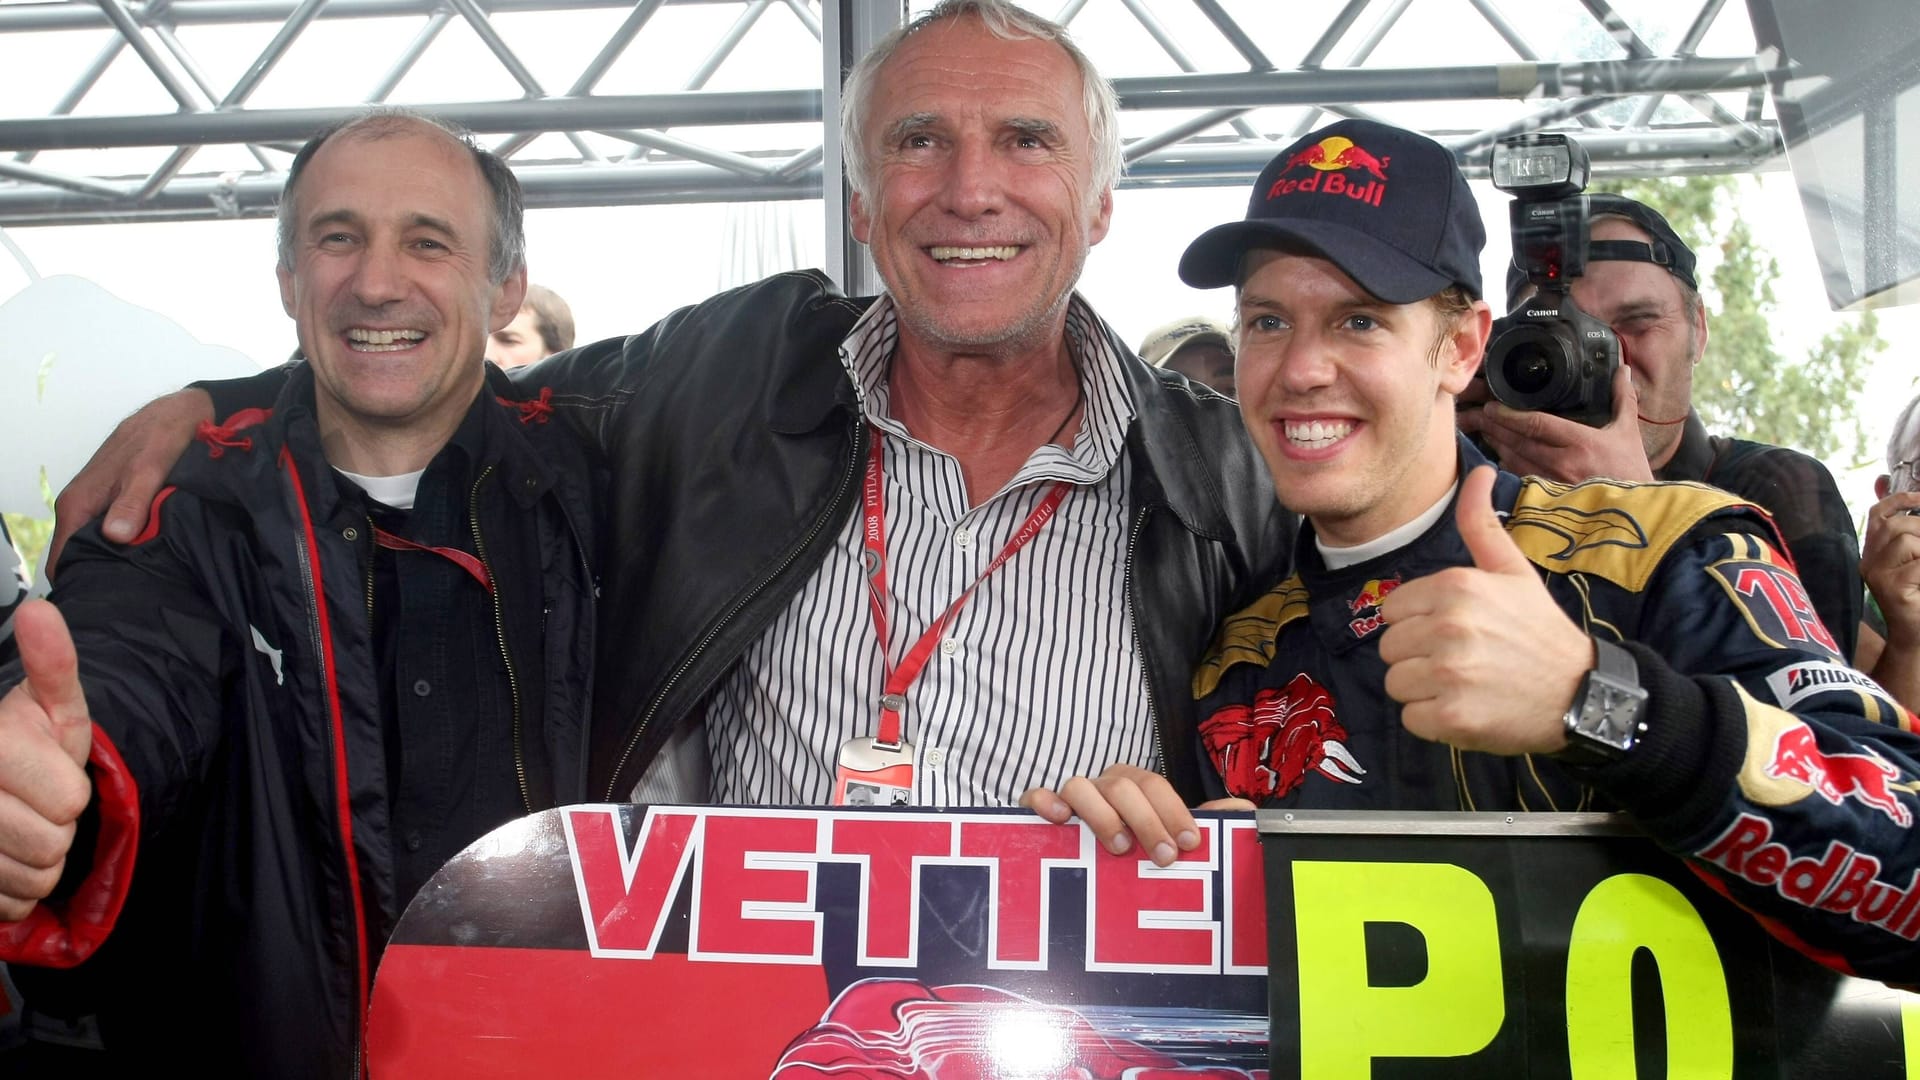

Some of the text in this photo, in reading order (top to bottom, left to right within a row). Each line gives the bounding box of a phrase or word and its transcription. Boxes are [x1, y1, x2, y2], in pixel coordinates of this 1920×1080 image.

[1267, 171, 1385, 207] Red Bull
[1526, 309, 1559, 317] Canon
[866, 456, 878, 507] PITLANE
[867, 515, 879, 541] 2008
[1014, 503, 1053, 549] PITLANE
[1694, 812, 1855, 908] Red
